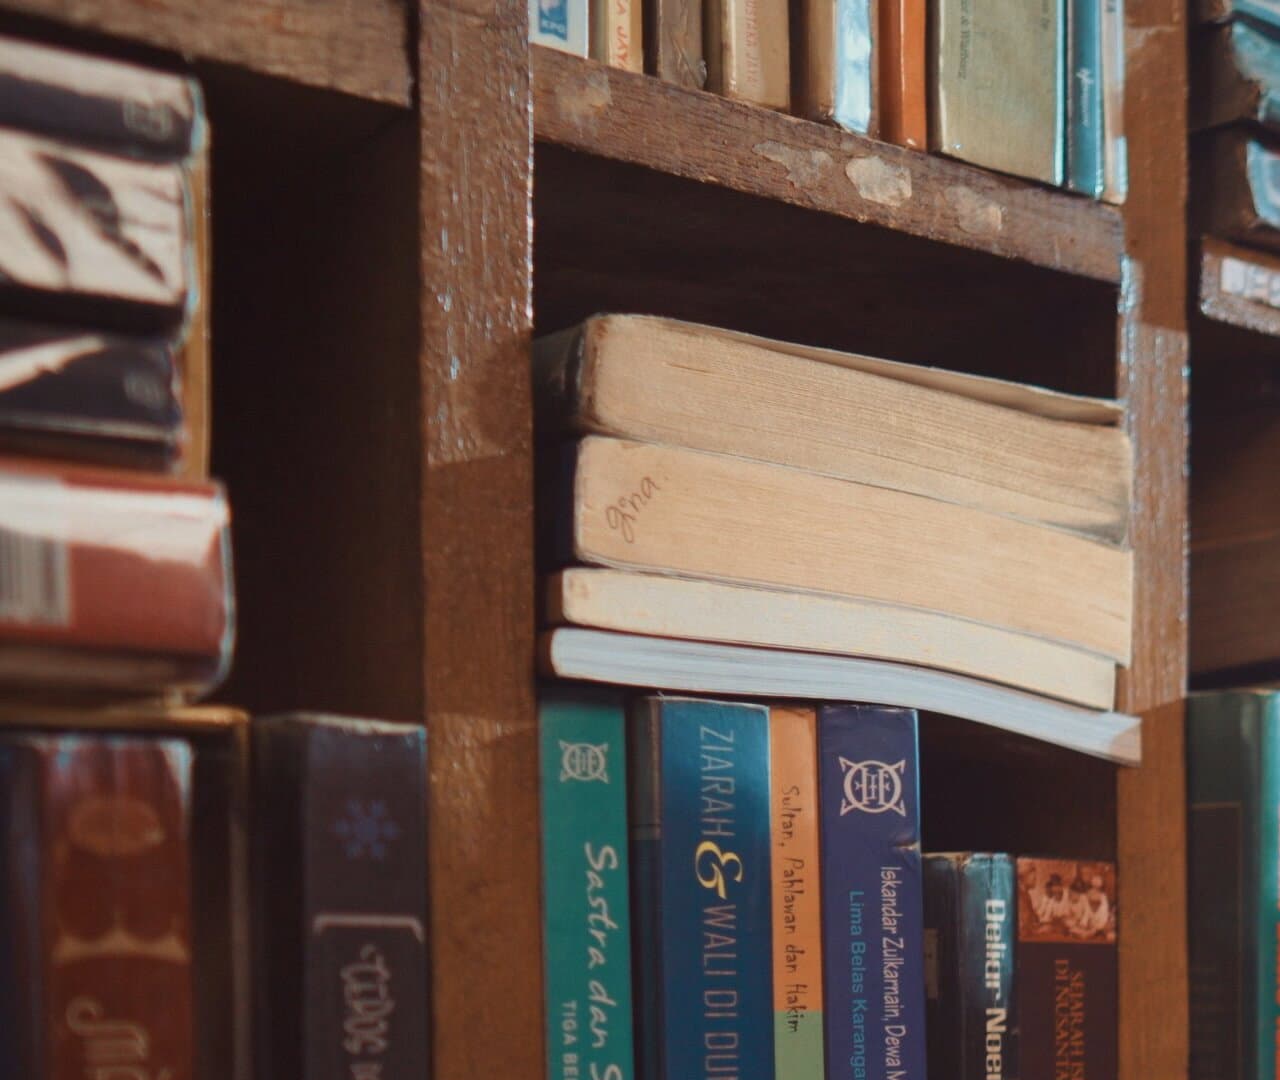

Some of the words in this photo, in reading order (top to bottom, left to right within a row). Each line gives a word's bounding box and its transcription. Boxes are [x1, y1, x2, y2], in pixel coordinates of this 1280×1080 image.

[698, 725, 736, 838] ZIARAH
[779, 784, 803, 848] Sultan,
[694, 840, 743, 899] &
[782, 857, 806, 935] Pahlawan
[880, 866, 904, 934] Iskandar
[584, 842, 619, 970] Sastra
[848, 889, 866, 936] Lima
[702, 903, 740, 977] WALI
[783, 943, 806, 975] dan
[849, 941, 867, 993] Belas
[702, 989, 739, 1019] DI
[784, 983, 809, 1034] Hakim
[880, 936, 905, 1022] Zulkarnain,
[561, 1000, 578, 1047] TIGA
[587, 979, 617, 1048] dan
[884, 1024, 907, 1068] Dewa
